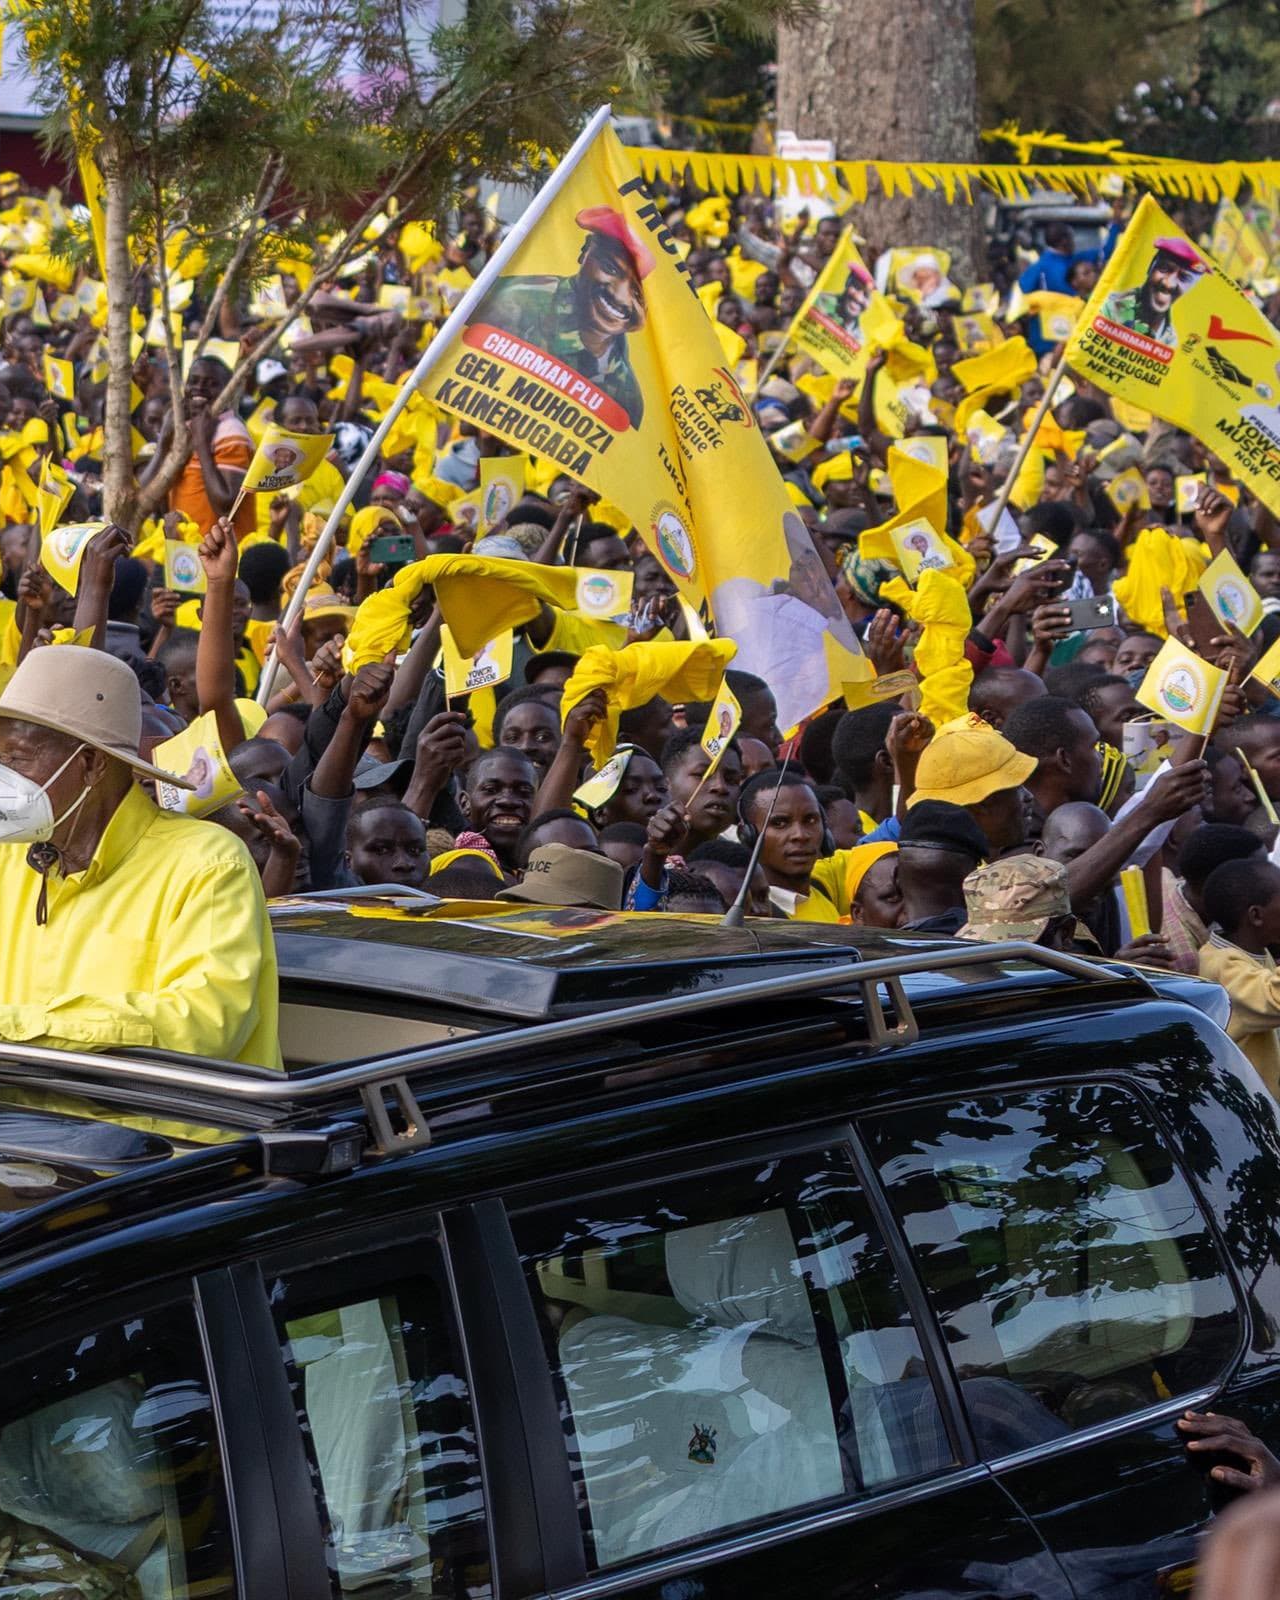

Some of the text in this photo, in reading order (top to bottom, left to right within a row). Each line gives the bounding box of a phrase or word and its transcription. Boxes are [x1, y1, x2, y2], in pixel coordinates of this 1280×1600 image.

[1078, 338, 1162, 388] KAINERUGABA
[1085, 327, 1170, 376] GEN. MUHOOZI
[1095, 318, 1153, 352] CHAIRMAN
[1153, 345, 1172, 360] PLU
[483, 333, 604, 411] CHAIRMAN PLU
[1086, 359, 1127, 384] NEXT
[435, 378, 593, 476] KAINERUGABA
[455, 352, 615, 454] GEN. MUHOOZI
[671, 384, 724, 450] Patriotic
[657, 442, 685, 496] Tuko
[1234, 450, 1262, 476] NOW
